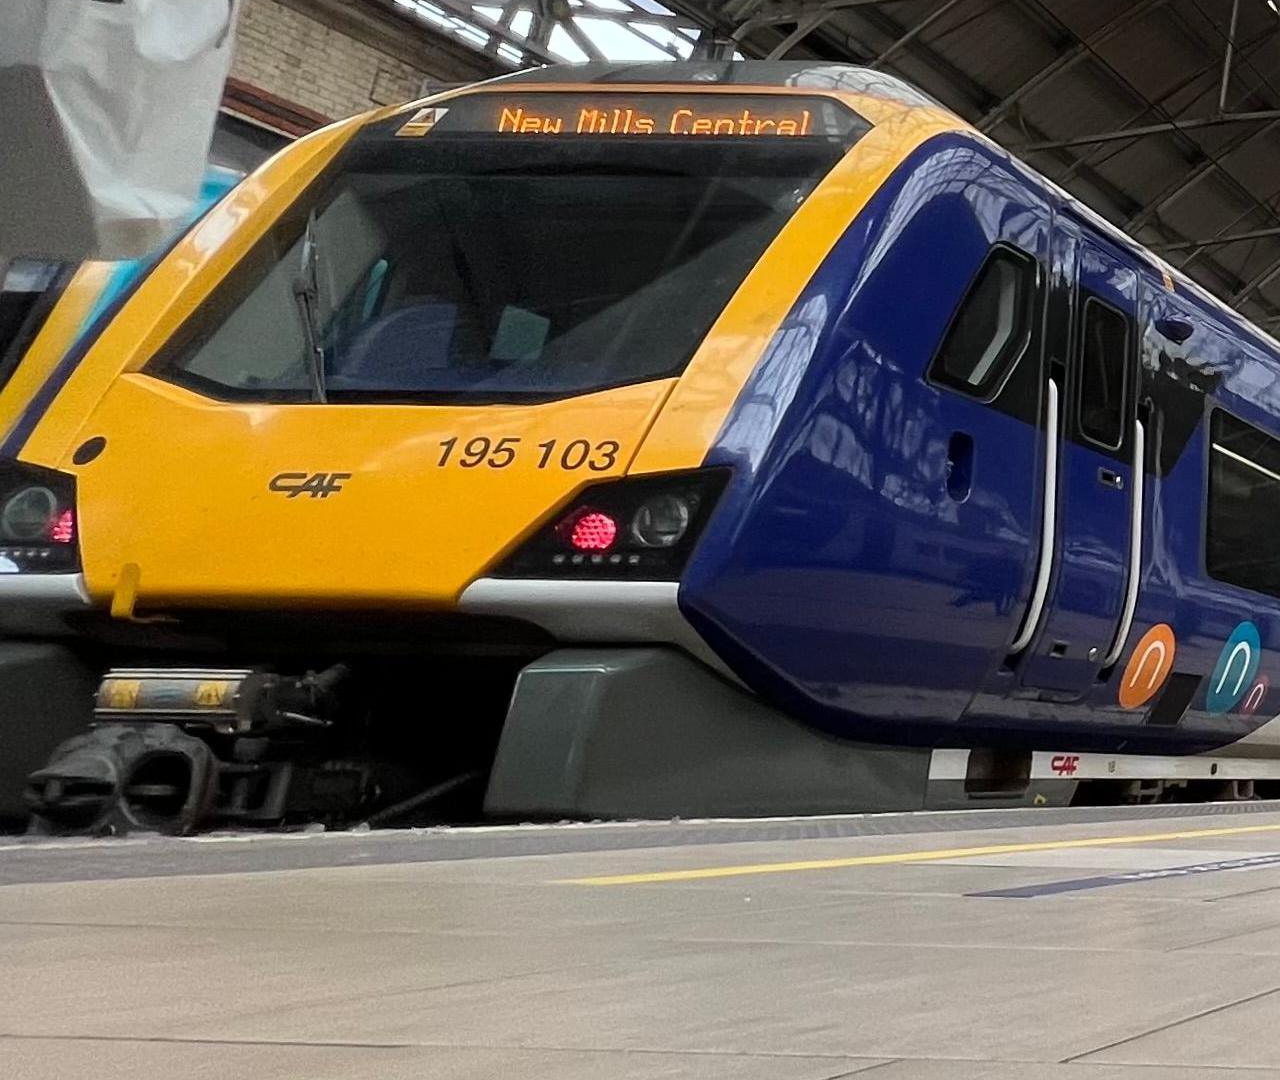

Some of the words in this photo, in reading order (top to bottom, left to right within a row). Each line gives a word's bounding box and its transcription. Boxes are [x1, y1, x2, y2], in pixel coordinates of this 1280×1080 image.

[498, 108, 562, 134] New
[576, 108, 654, 134] Mills
[669, 109, 810, 136] Central
[437, 436, 520, 469] 195
[537, 438, 620, 472] 103
[268, 472, 352, 498] CAF
[1051, 756, 1080, 776] CAF
